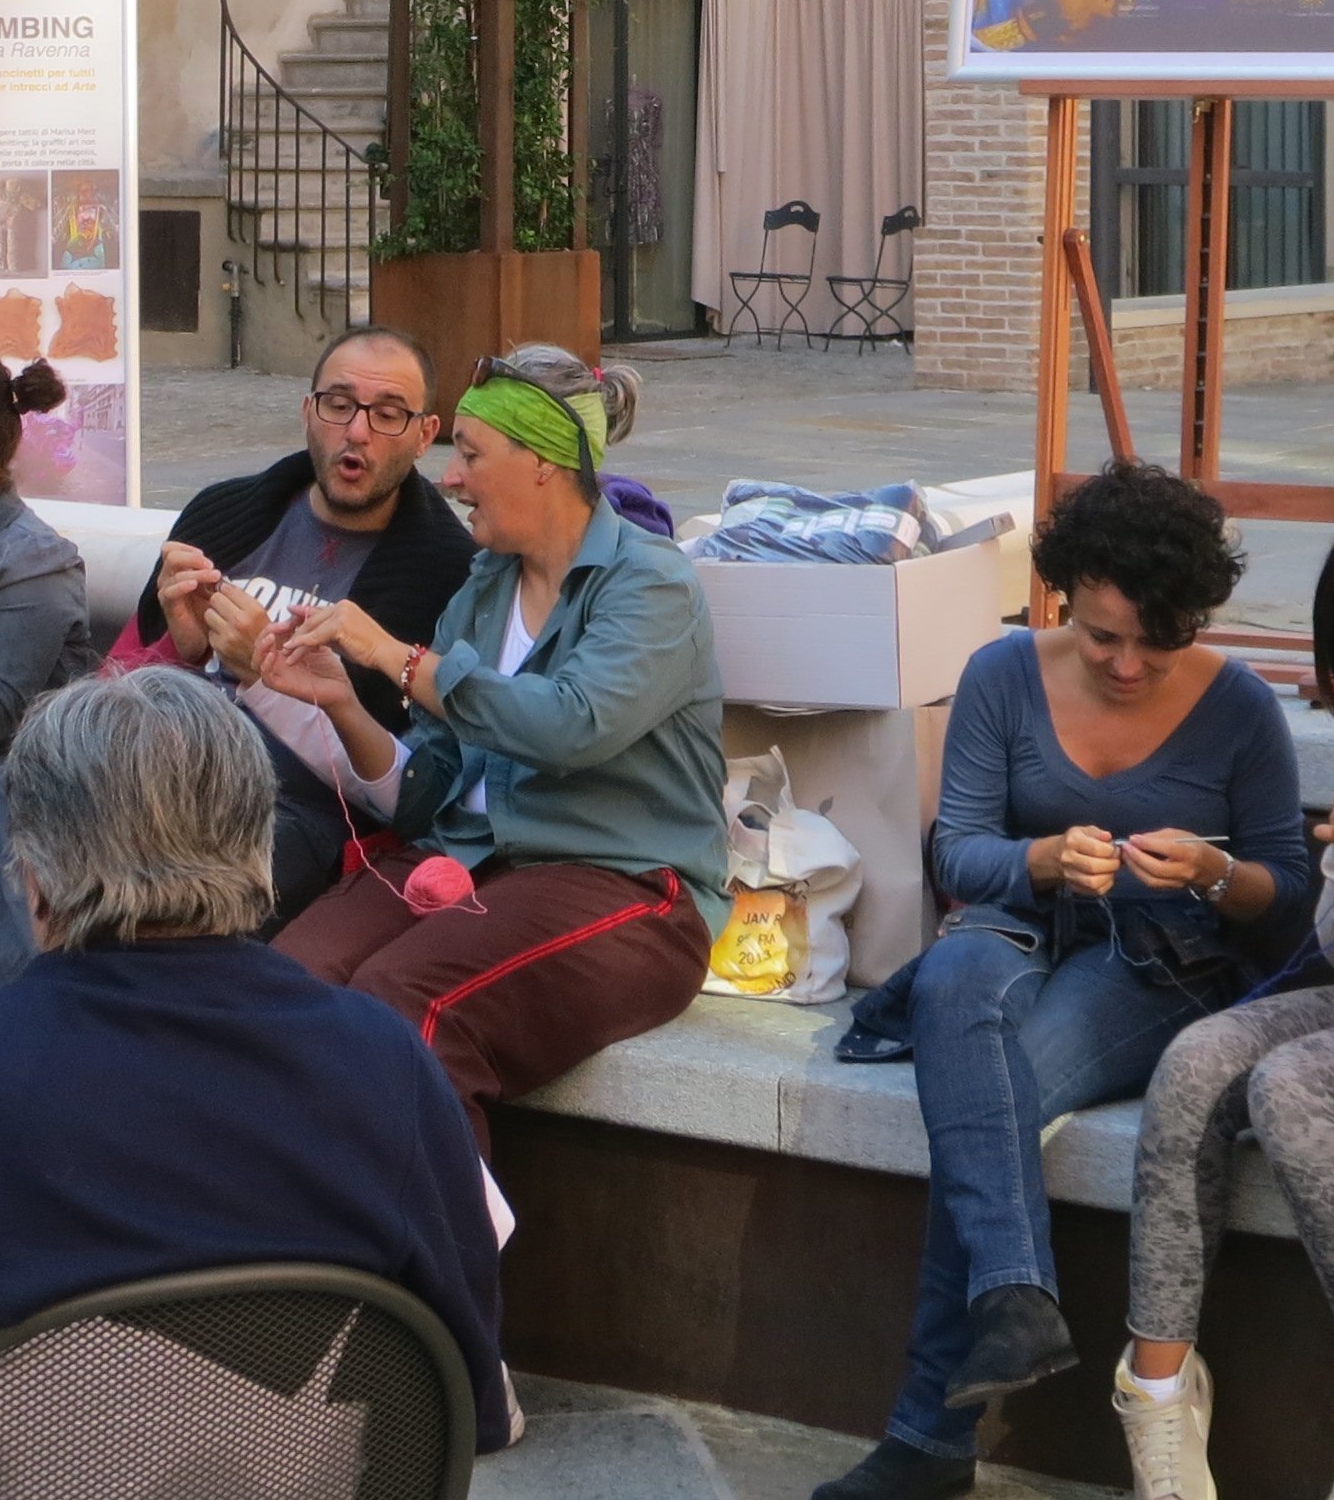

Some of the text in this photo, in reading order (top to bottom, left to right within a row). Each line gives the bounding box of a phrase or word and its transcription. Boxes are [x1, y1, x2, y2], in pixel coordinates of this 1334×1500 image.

[10, 41, 90, 58] Ravenna
[47, 69, 65, 79] per
[10, 81, 51, 91] intrecci
[54, 81, 68, 91] ad
[71, 81, 96, 91] Arte
[18, 127, 39, 136] tattili
[41, 127, 48, 136] di
[50, 127, 75, 135] Marisa
[77, 127, 95, 135] Merz
[32, 138, 39, 146] la
[41, 137, 66, 148] graffiti
[68, 137, 79, 146] art
[14, 148, 36, 156] strade
[39, 148, 47, 156] di
[1, 158, 21, 168] porta
[56, 158, 75, 166] nelle
[742, 912, 770, 926] JAN
[738, 949, 772, 965] 2013
